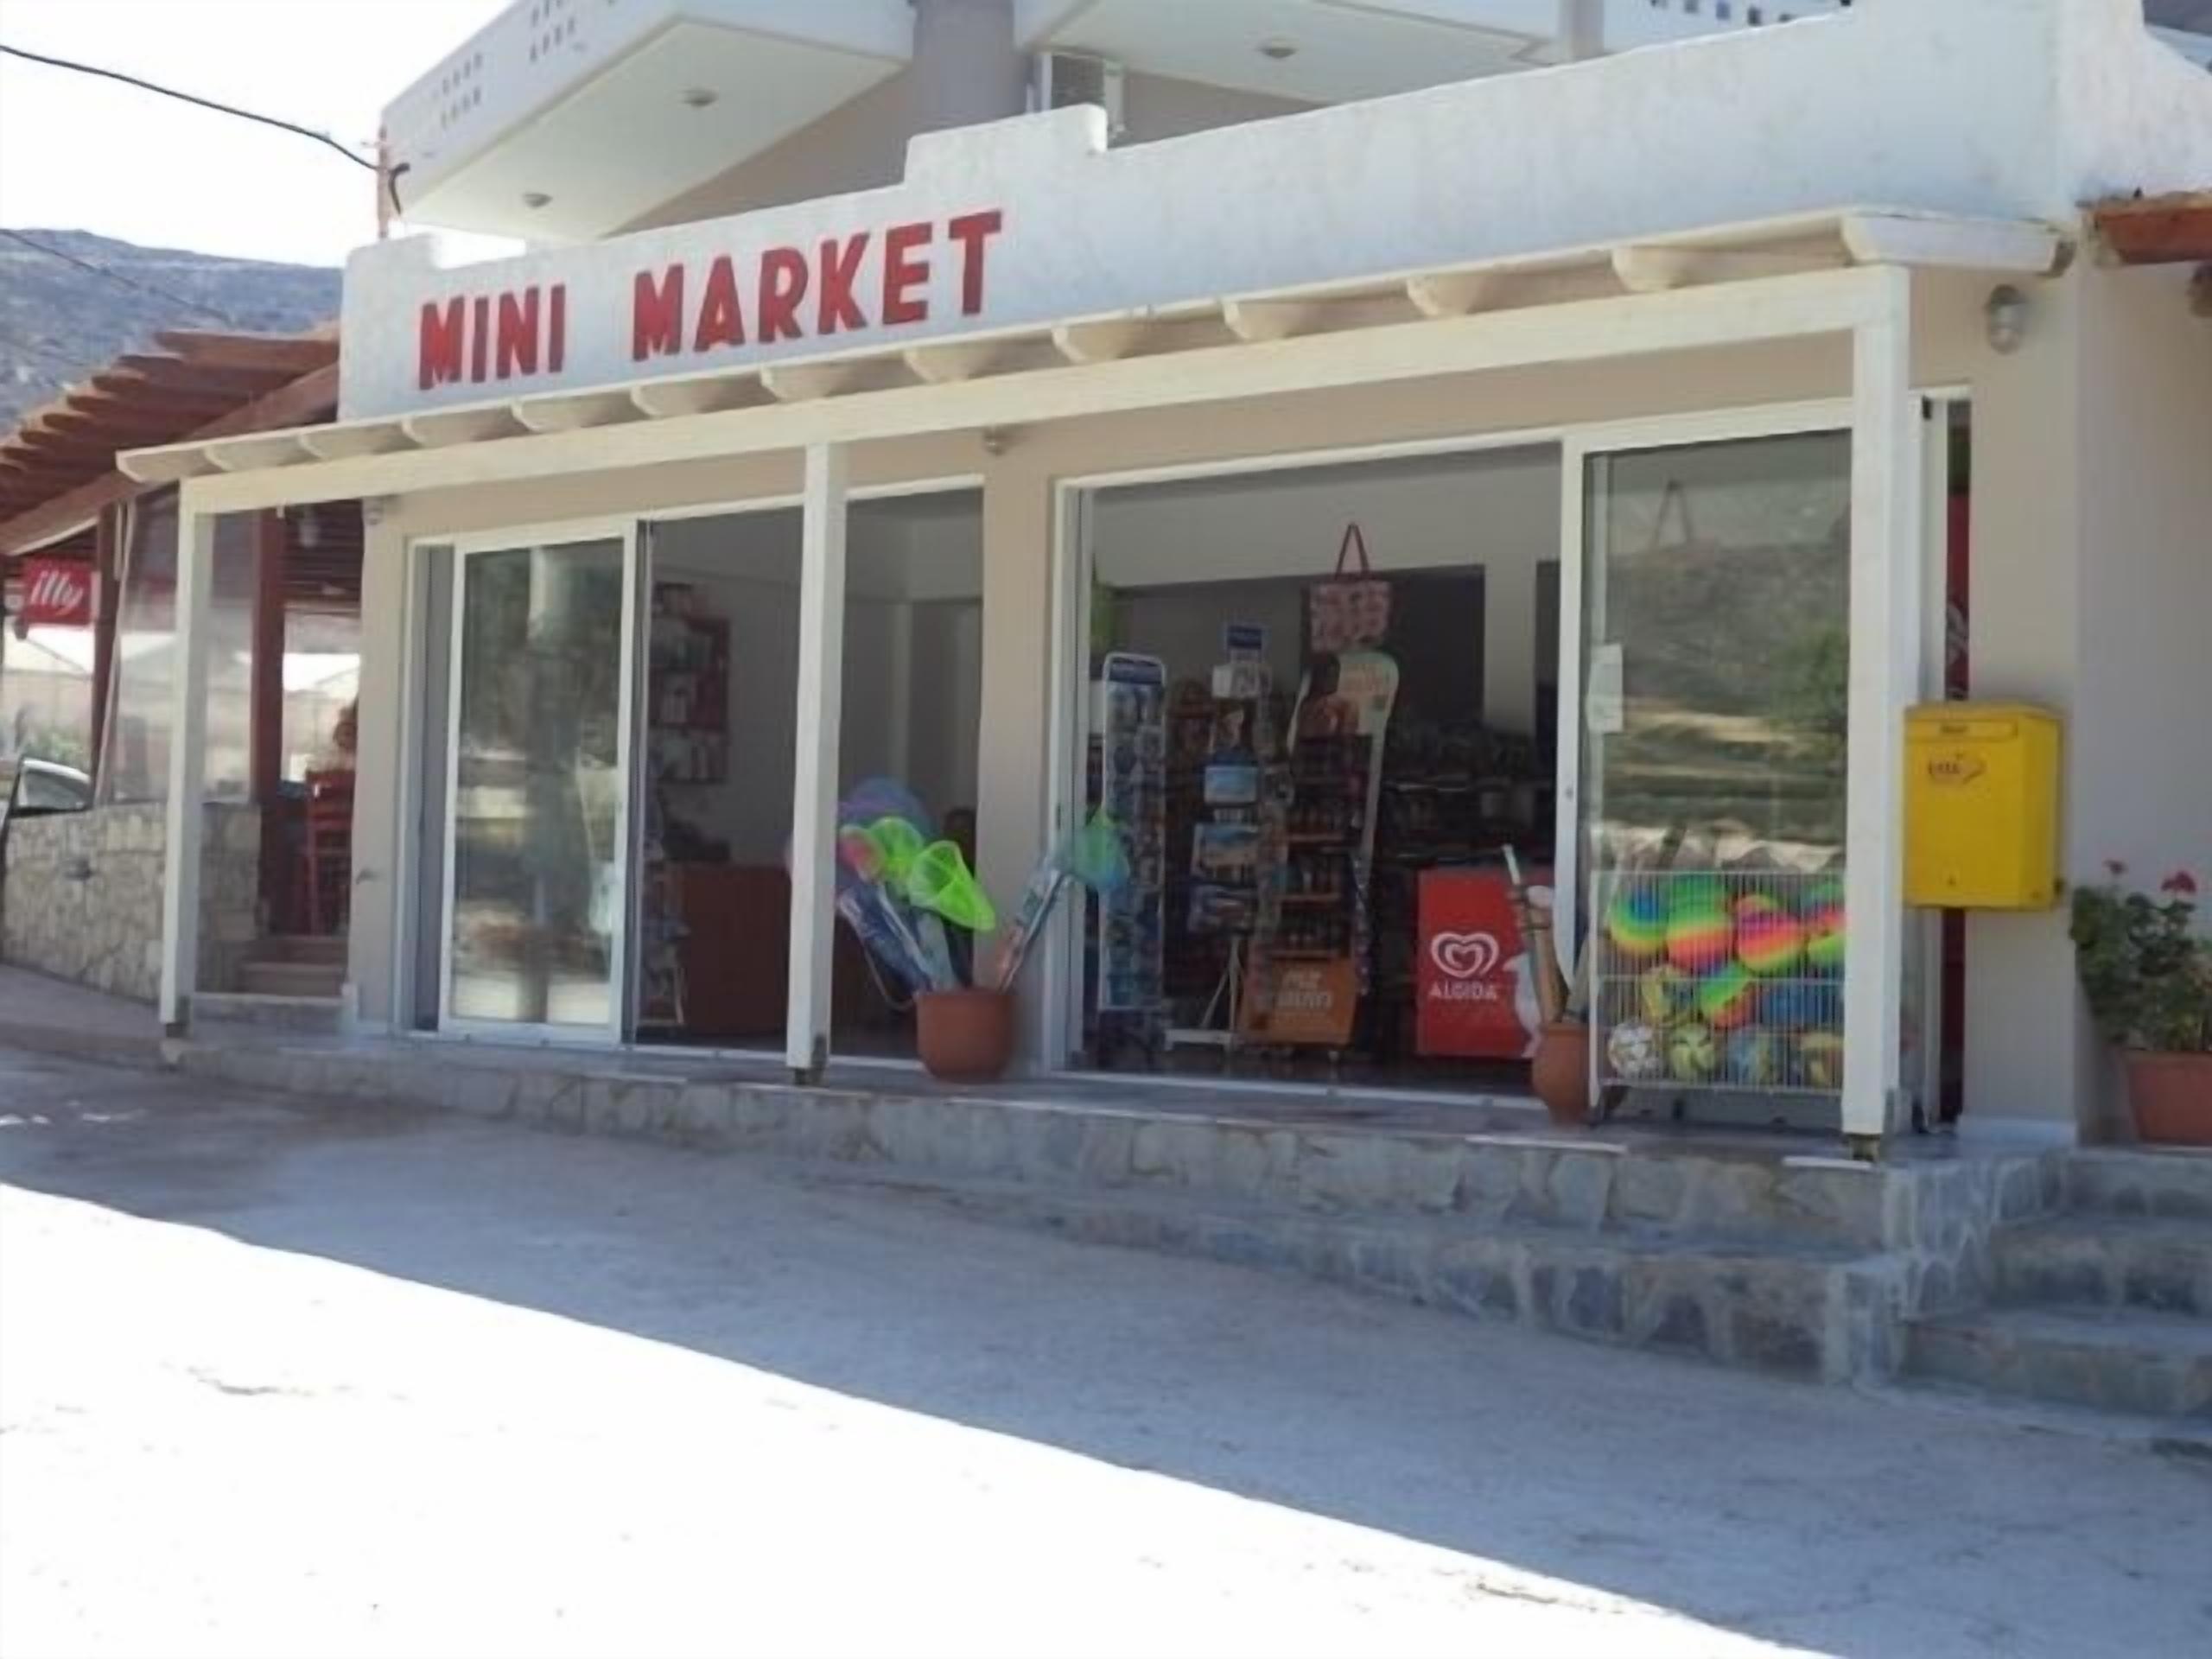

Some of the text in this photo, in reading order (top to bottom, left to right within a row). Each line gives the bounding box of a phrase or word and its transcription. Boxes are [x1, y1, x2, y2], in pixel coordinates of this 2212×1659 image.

[419, 208, 1002, 390] MINI MARKET
[30, 570, 84, 616] illy
[1429, 981, 1497, 1000] ALGIDA
